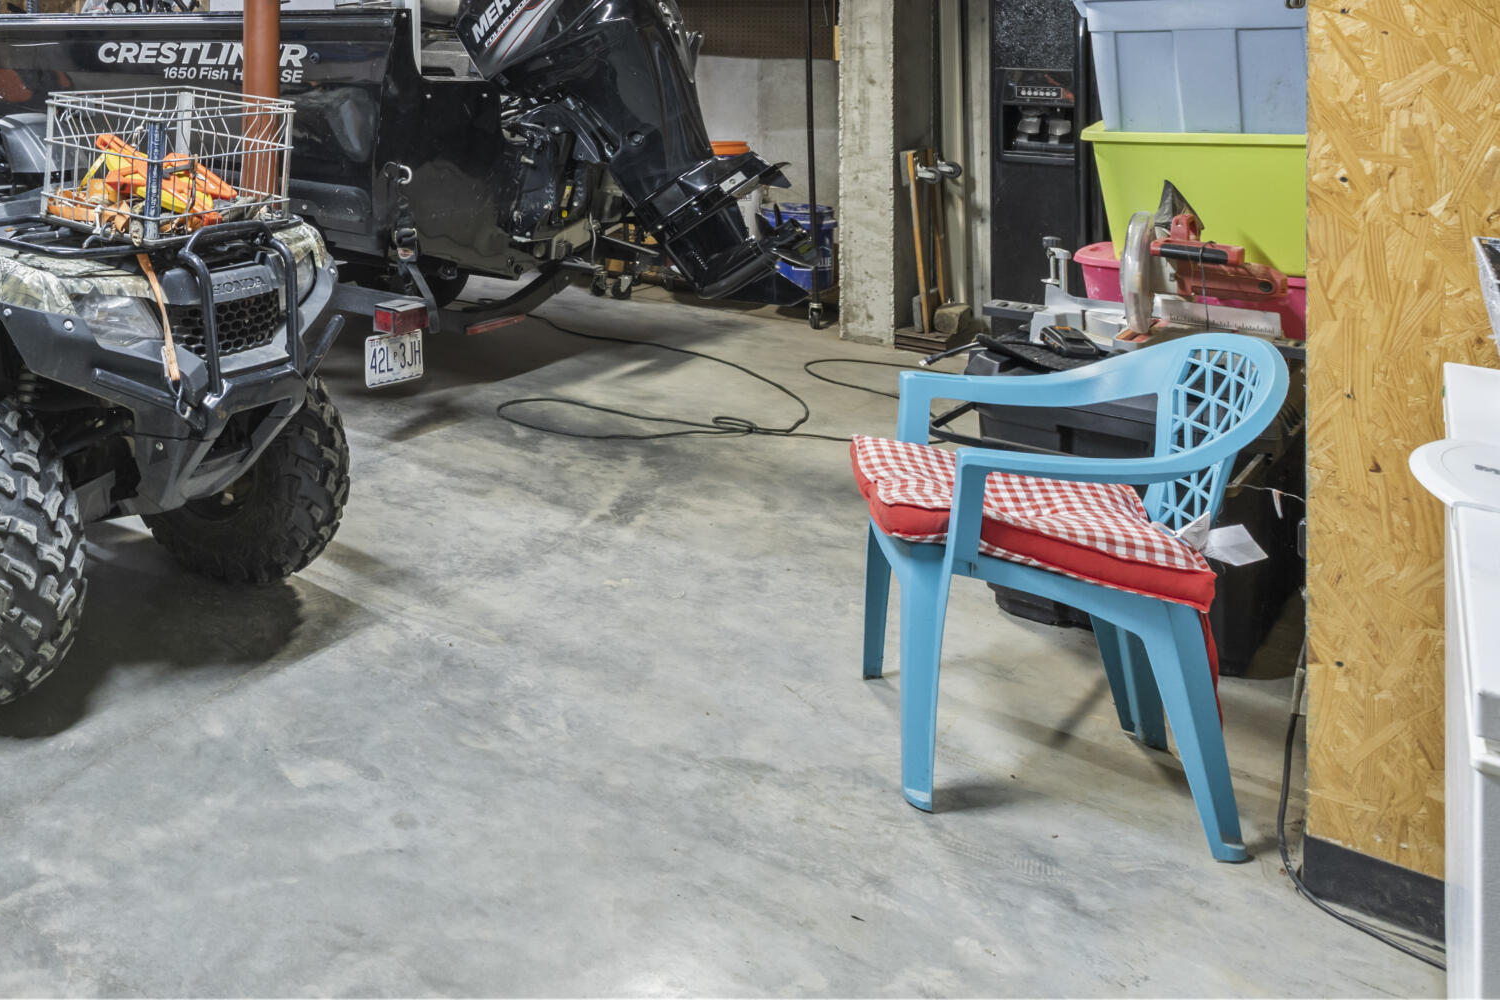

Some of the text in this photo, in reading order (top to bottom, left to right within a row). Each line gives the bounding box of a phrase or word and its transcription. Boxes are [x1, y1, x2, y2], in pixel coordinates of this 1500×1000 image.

[98, 41, 308, 67] CRESTLINR
[163, 67, 197, 80] 1650
[199, 66, 229, 81] Fish
[280, 69, 304, 84] SE
[213, 275, 267, 297] HONDA
[369, 346, 393, 375] 42L
